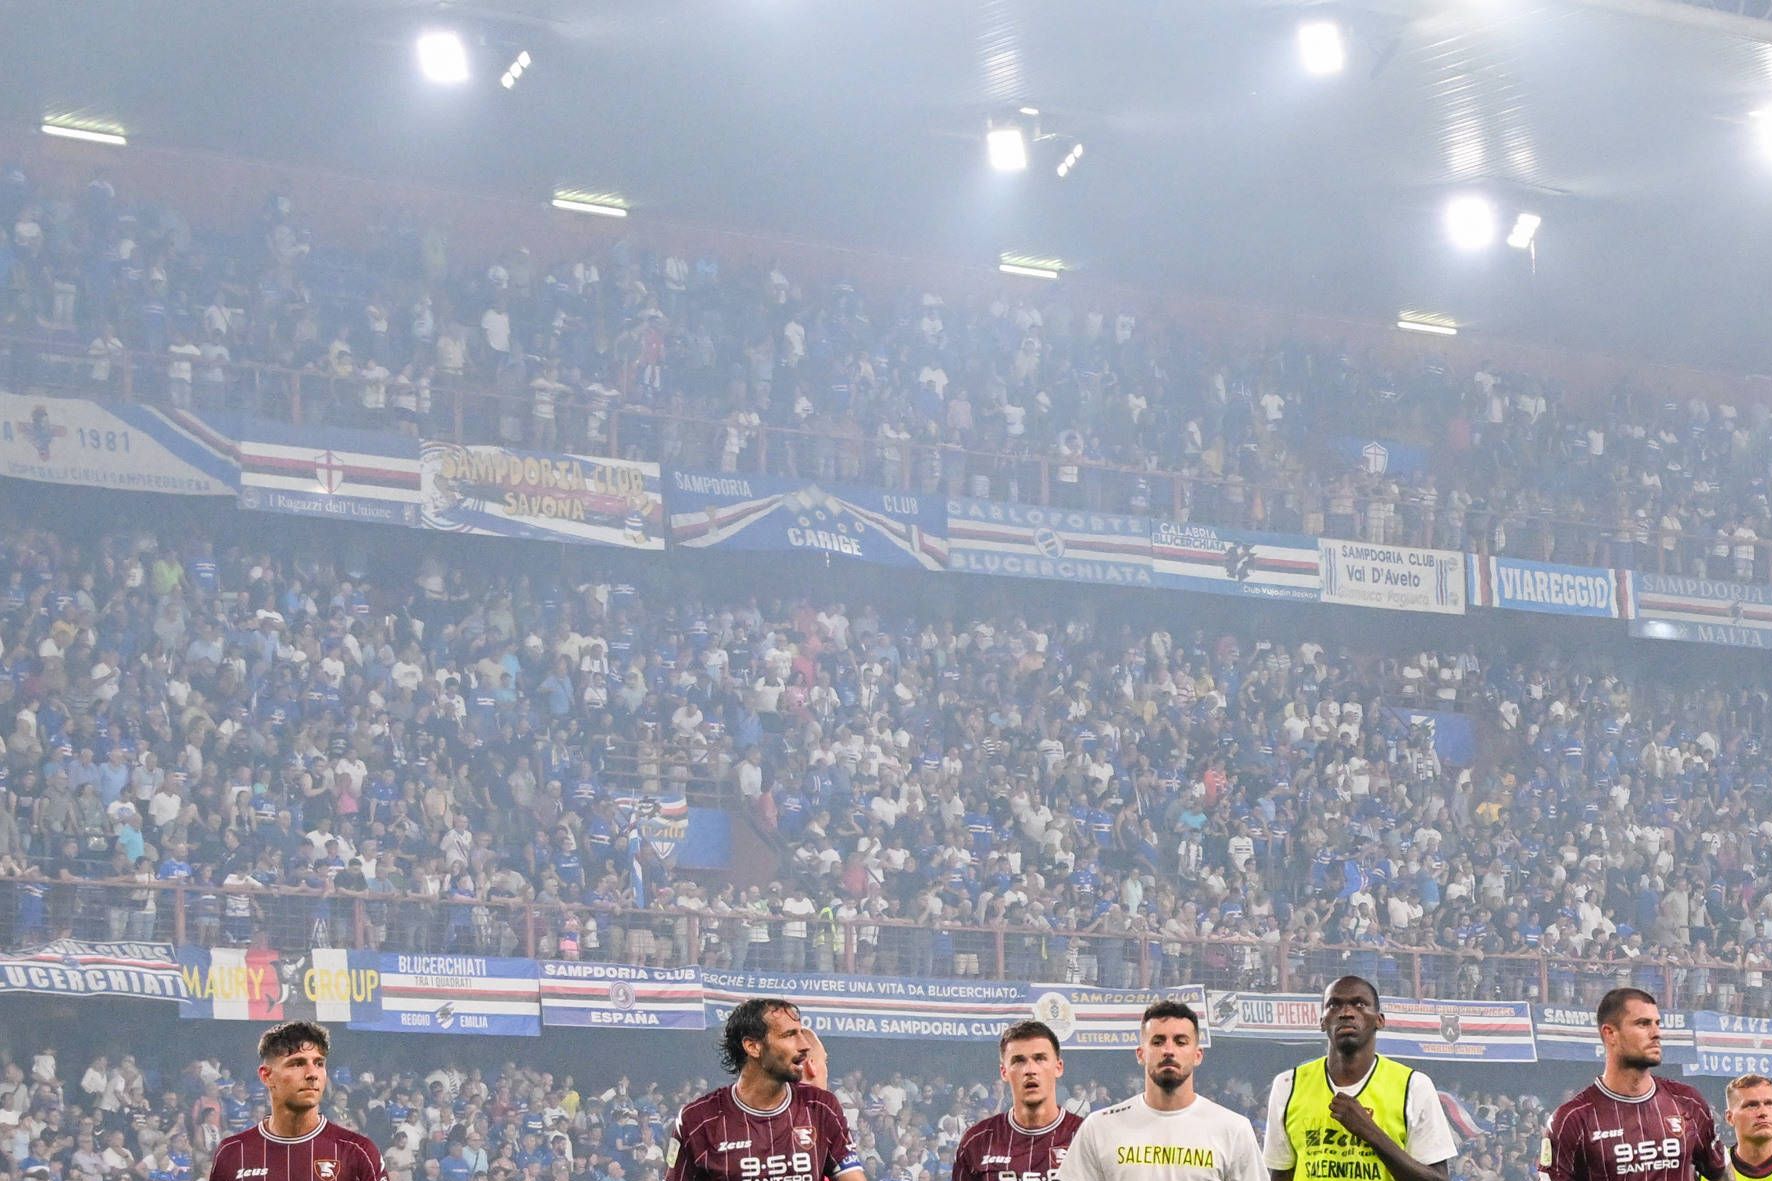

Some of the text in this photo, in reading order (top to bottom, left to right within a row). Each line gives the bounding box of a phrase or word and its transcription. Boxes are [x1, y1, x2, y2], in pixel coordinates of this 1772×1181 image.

[77, 427, 130, 453] 1981
[443, 453, 644, 492] SAMPDORIA CLUB
[674, 471, 752, 498] SAMPDORIA
[277, 495, 323, 514] Ragazzi
[325, 501, 392, 520] dell'Unione
[503, 492, 586, 520] SAVONA
[884, 496, 919, 515] CLUB
[1161, 522, 1217, 540] CALABRIA
[787, 527, 863, 557] CARIGE
[1342, 544, 1435, 567] SAMPDORIA CLUB
[950, 551, 1151, 582] BLUCERCHIATA
[1347, 565, 1420, 587] Val D'Aveto
[1500, 567, 1609, 609] VIAREGGIO
[1643, 577, 1764, 601] SAMPDORIA
[398, 955, 487, 976] BLUCERCHIATI
[544, 963, 696, 981] SAMPDORIA CLUB
[182, 965, 378, 1002] MAURY GROUP
[758, 977, 797, 990] BELLO
[801, 979, 845, 993] VIVERE
[849, 982, 875, 993] UNA
[877, 983, 905, 995] VITA
[908, 985, 925, 996] DA
[401, 1013, 488, 1028] REGGIO EMILIA
[591, 1008, 660, 1025] ESPAÑA
[1242, 1000, 1319, 1025] CLUB PIETRA
[1544, 1008, 1598, 1025] SAMPD
[814, 1017, 830, 1031] DI
[835, 1018, 876, 1032] VARA
[881, 1019, 967, 1036] SAMPDORIA
[1077, 1032, 1138, 1043] LETTERA DA
[1592, 1128, 1624, 1140] Zeus
[717, 1140, 752, 1152] Zeus
[981, 1155, 1012, 1166] Zeus
[1117, 1145, 1215, 1168] SALERNITANA
[1616, 1158, 1680, 1174] SANTERO
[235, 1168, 268, 1180] Zeus
[1305, 1160, 1382, 1180] SALERNITANA
